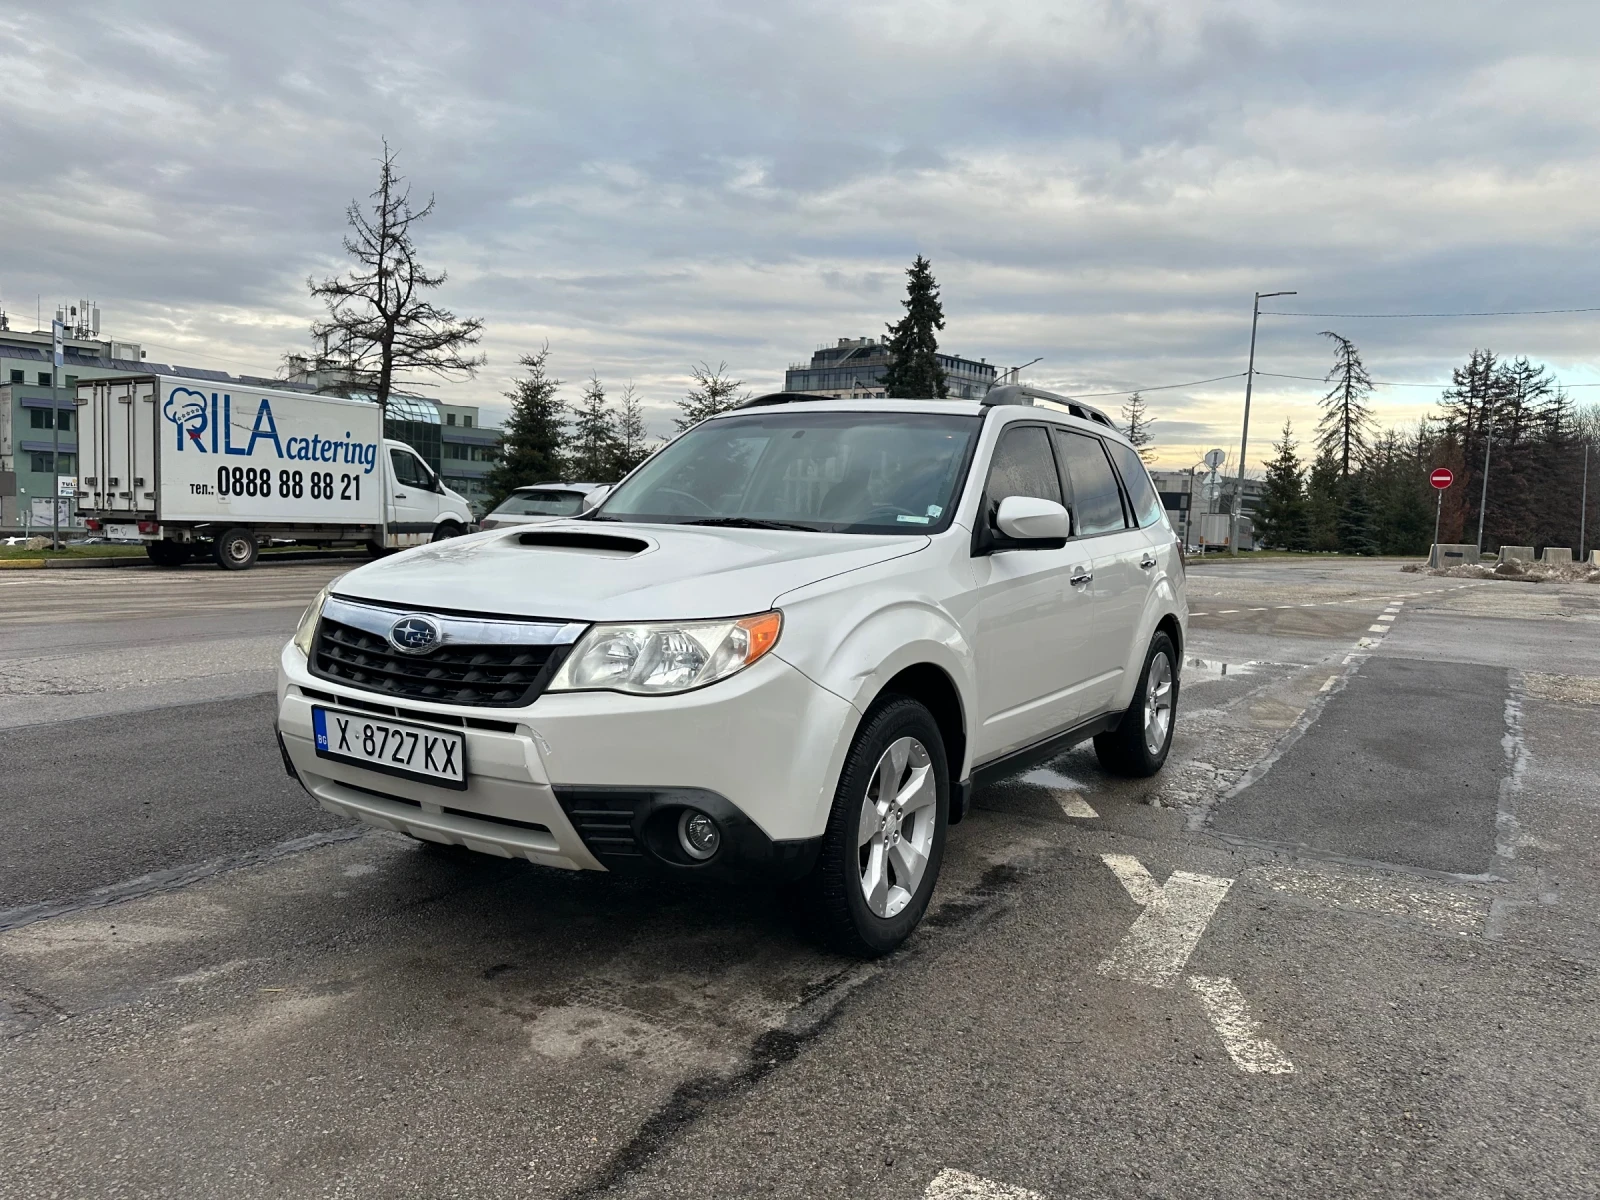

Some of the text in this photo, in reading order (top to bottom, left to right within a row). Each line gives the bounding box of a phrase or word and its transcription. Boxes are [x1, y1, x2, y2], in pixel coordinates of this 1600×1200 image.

[164, 387, 377, 474] RILA catering
[190, 466, 360, 500] тел.: 0888 88 88 21
[318, 734, 327, 745] BG
[336, 718, 352, 752] X
